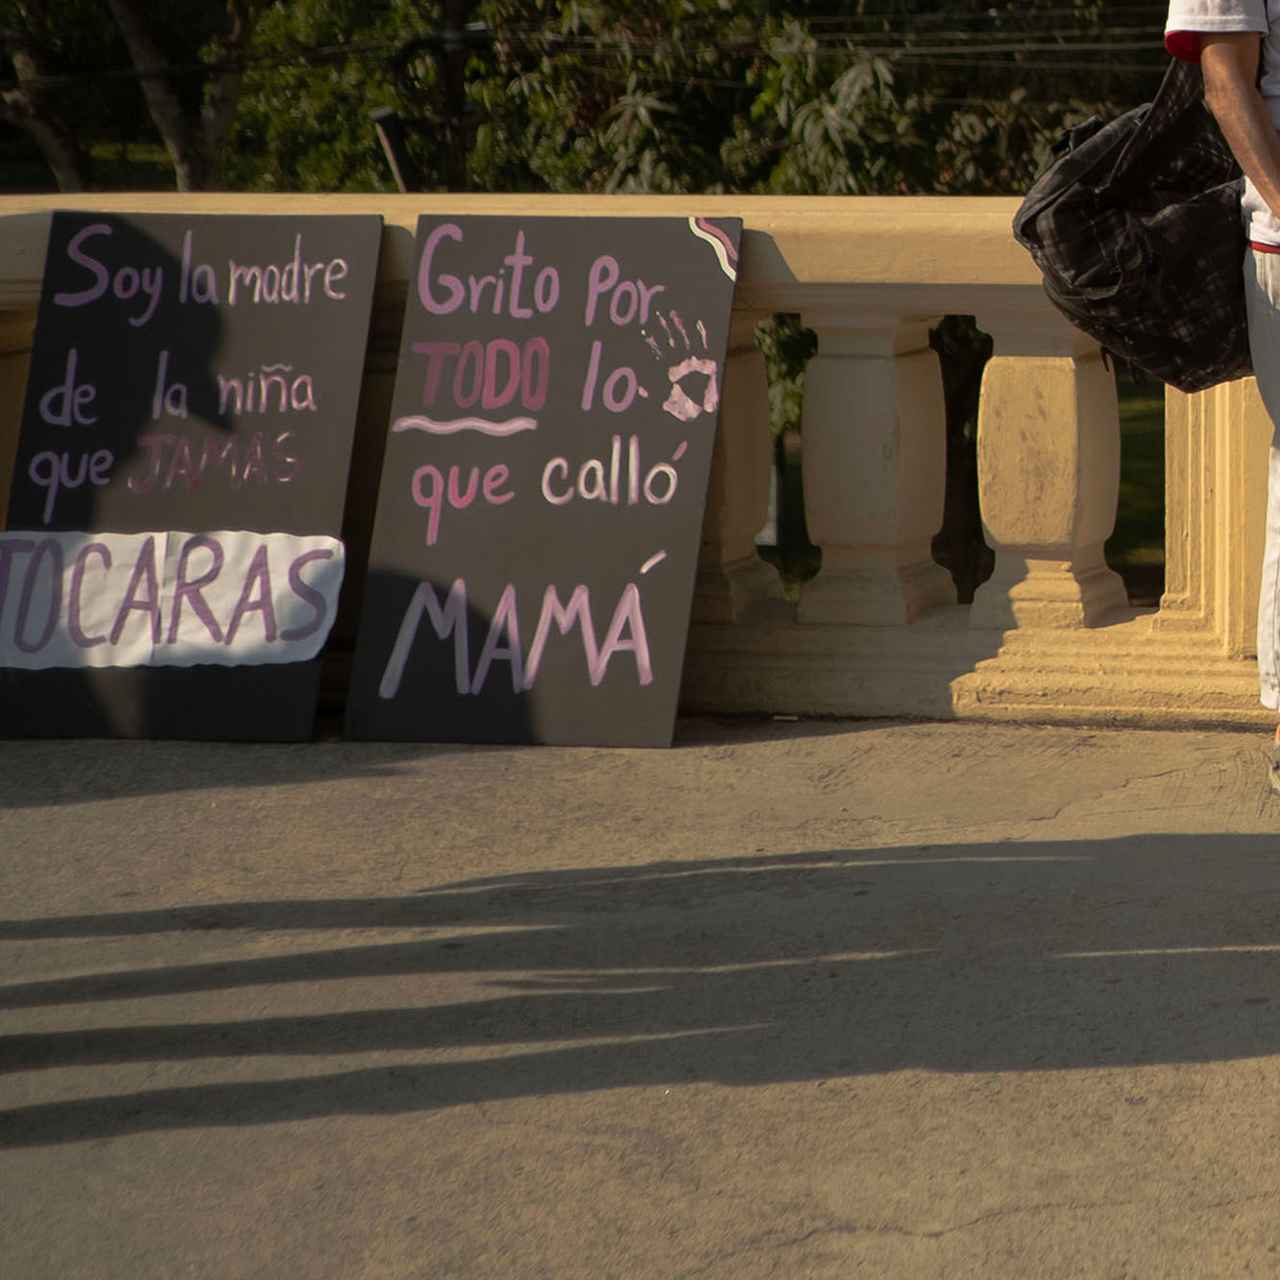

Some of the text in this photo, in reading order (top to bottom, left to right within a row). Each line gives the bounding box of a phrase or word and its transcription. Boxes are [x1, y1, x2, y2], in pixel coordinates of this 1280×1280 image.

[53, 223, 348, 327] Soy la madre
[418, 223, 665, 326] Grito Por
[39, 348, 318, 427] de la niña
[413, 336, 550, 412] TODO
[28, 448, 114, 525] que
[411, 434, 688, 546] que calló
[0, 534, 334, 653] TOCARAS
[379, 550, 668, 700] MAMÁ
